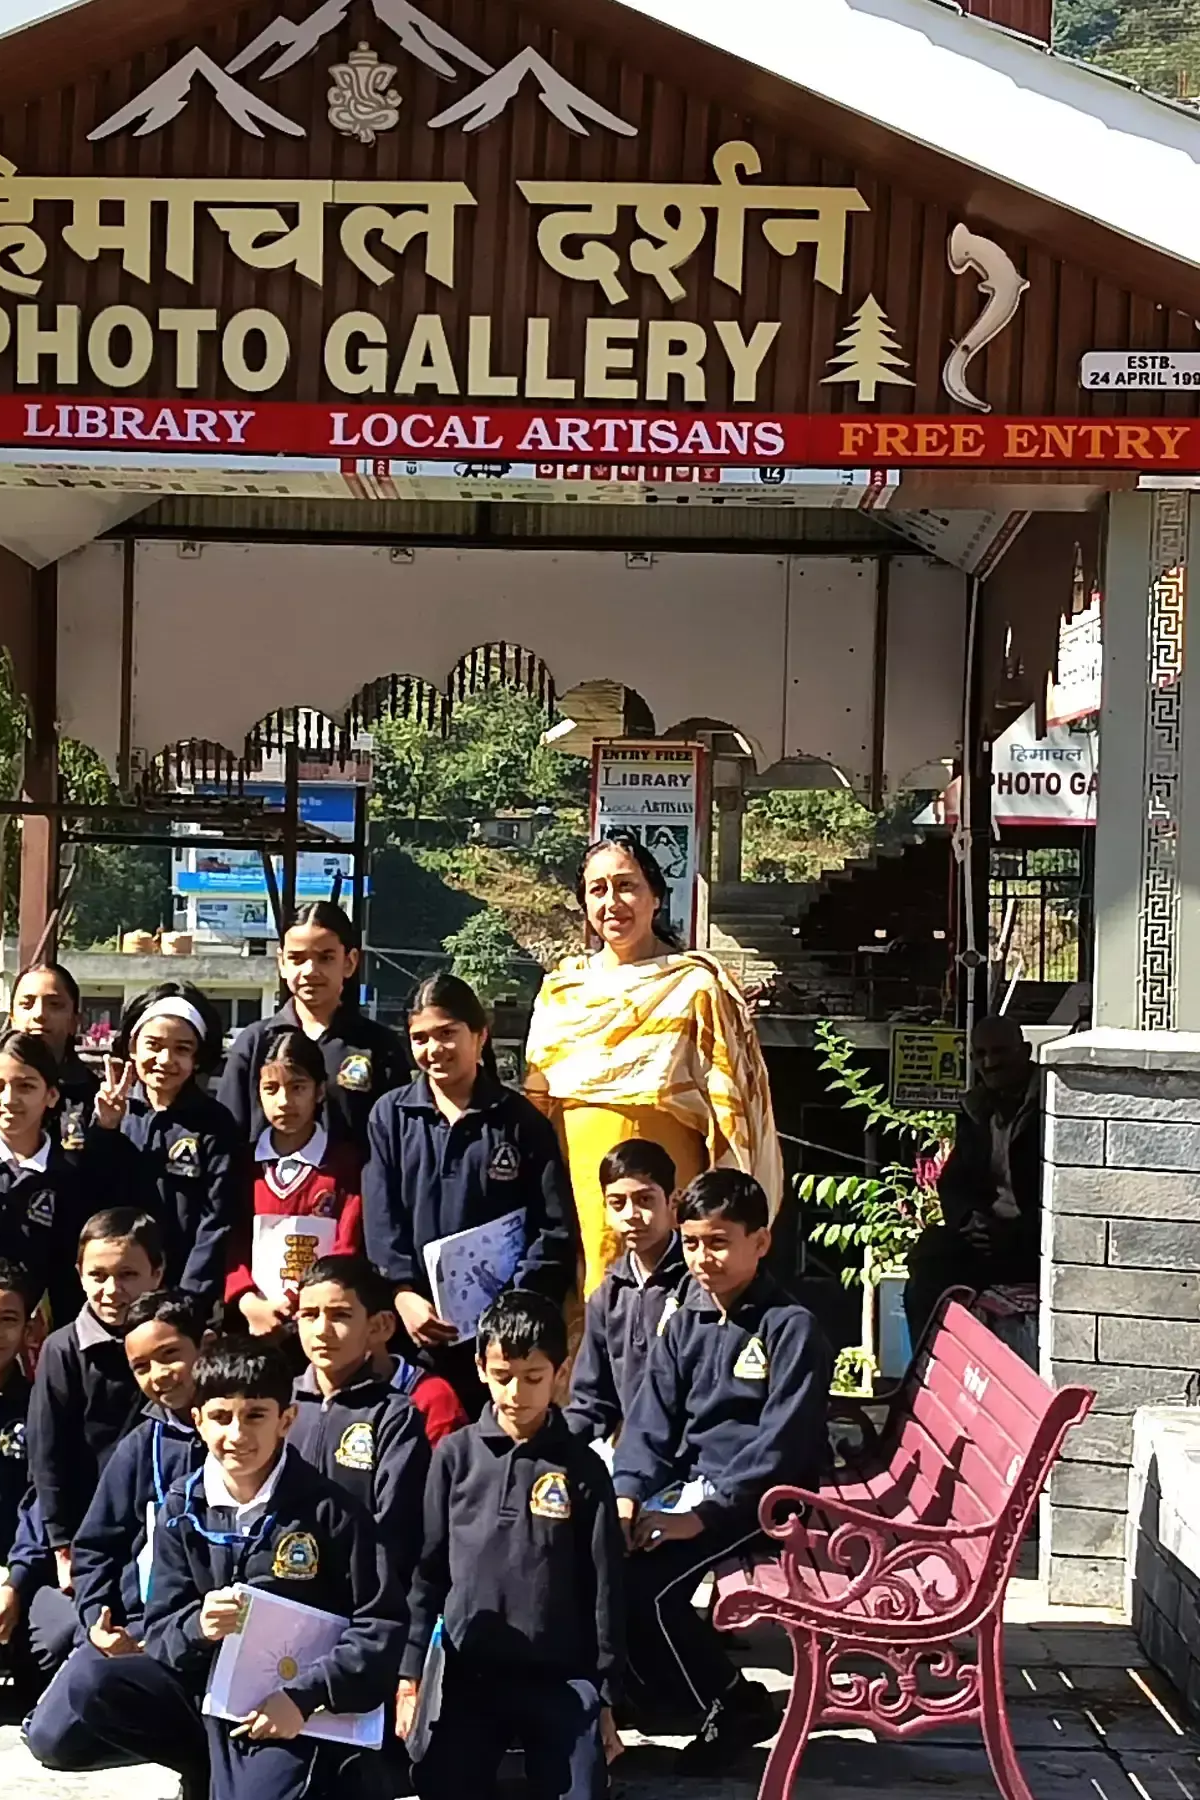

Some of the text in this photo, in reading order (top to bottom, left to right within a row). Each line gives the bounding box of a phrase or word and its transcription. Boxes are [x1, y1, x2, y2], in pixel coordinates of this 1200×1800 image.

[516, 139, 870, 305] दर्शन
[323, 310, 782, 402] GALLERY
[1127, 355, 1176, 370] ESTB.
[1089, 371, 1111, 386] 24
[1115, 371, 1168, 386] APRIL
[23, 403, 256, 444] LIBRARY
[329, 412, 504, 454] LOCAL
[516, 418, 786, 456] ARTISANS
[838, 421, 986, 459] FREE
[1004, 424, 1192, 461] ENTRY
[601, 749, 693, 761] ENTRY FREE
[1010, 744, 1083, 763] हिमाचल
[603, 766, 692, 787] LIBRARY
[990, 772, 1062, 795] HOTO
[640, 799, 694, 814] ARTISANS
